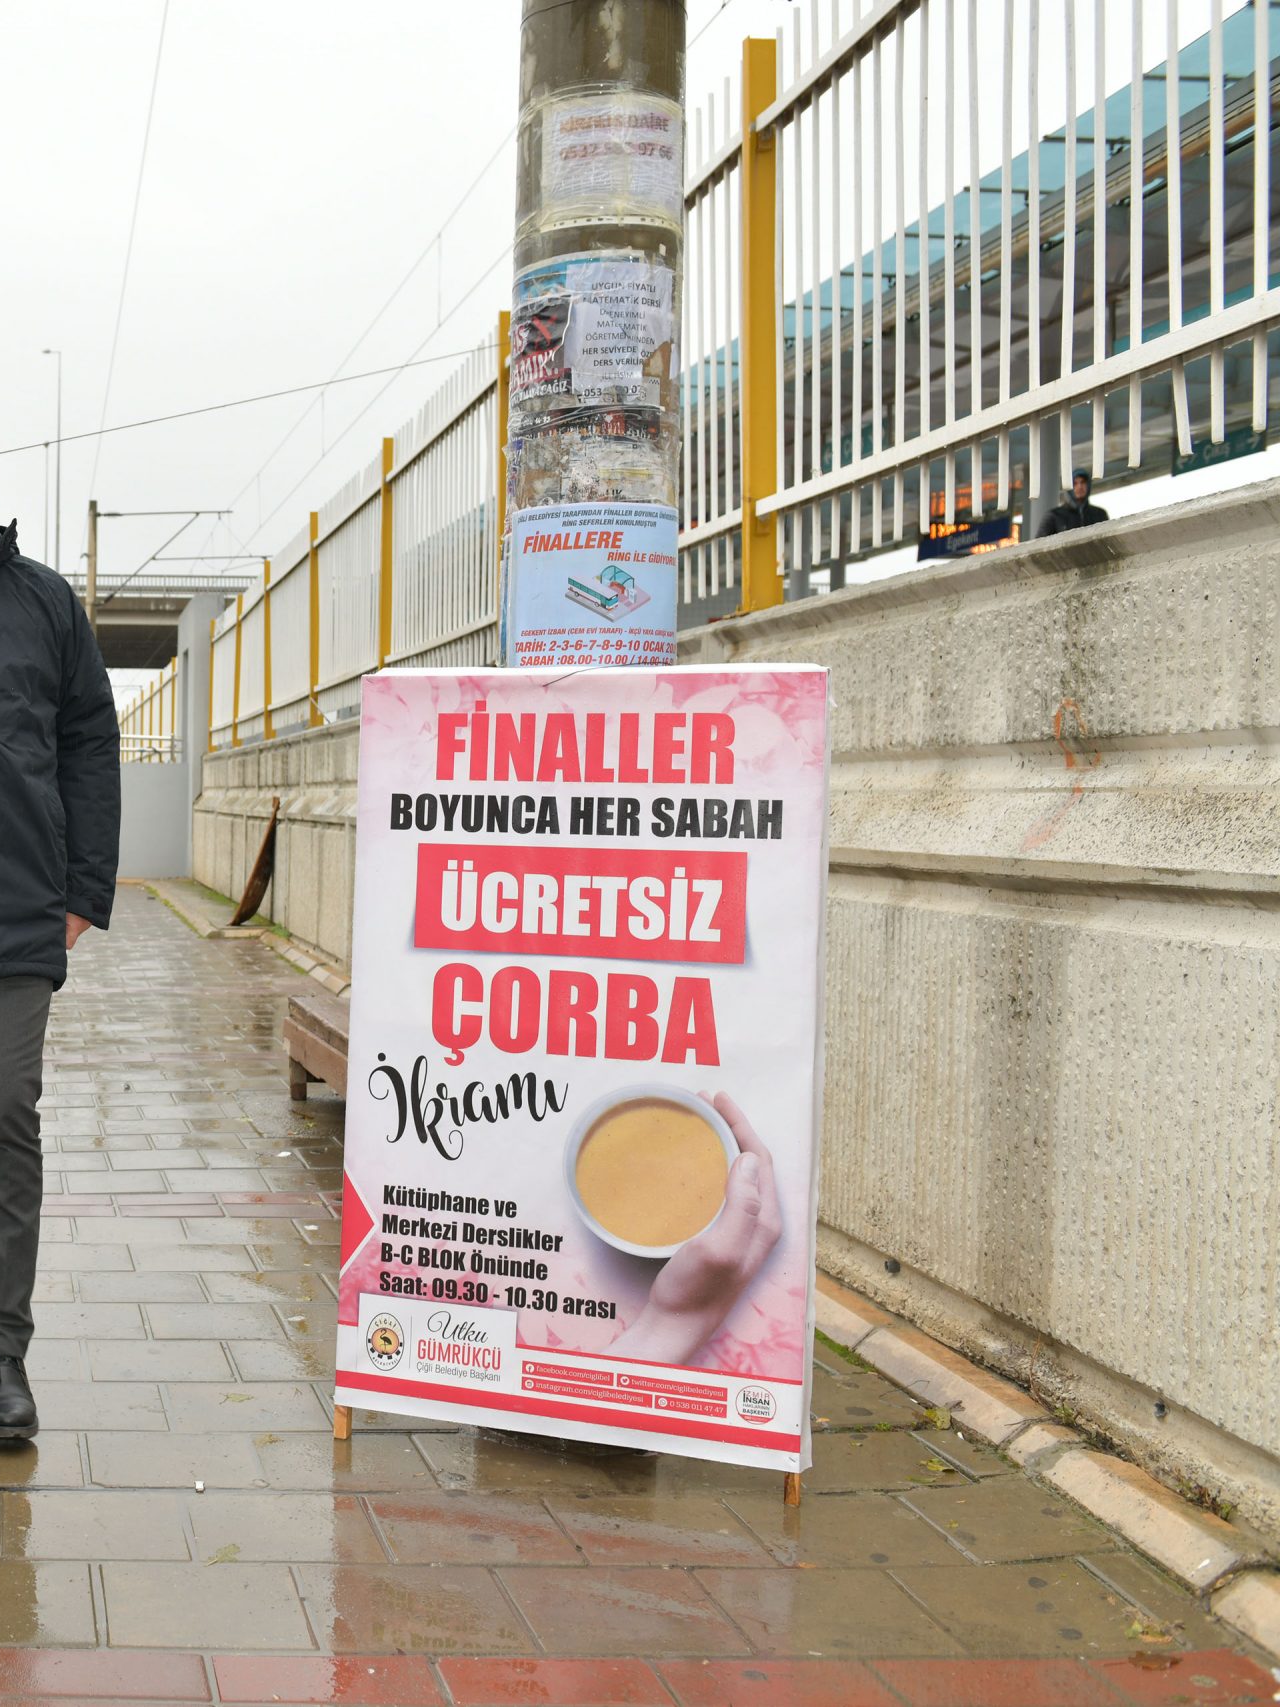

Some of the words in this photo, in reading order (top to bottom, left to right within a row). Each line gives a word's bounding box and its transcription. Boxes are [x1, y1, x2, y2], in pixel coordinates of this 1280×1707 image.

[641, 297, 661, 308] DERSİ
[582, 347, 599, 356] HER
[600, 345, 637, 355] SEVİYEDE
[593, 359, 614, 367] DERS
[615, 357, 644, 366] VERİLİR
[562, 509, 602, 518] TARAFINDAN
[603, 507, 633, 517] FİNALLER
[578, 518, 614, 527] SEFERLERİ
[615, 519, 657, 528] KONULMUŞTUR
[523, 530, 624, 554] FİNALLERE
[607, 550, 631, 562] RİNG
[633, 551, 647, 563] İLE
[547, 628, 567, 636] İZBAN
[586, 627, 598, 635] EVİ
[515, 638, 546, 653] TARİH:
[549, 639, 641, 651] 2-3-6-7-8-9-10
[642, 641, 665, 653] OCAK
[520, 655, 554, 666] SABAH
[435, 700, 736, 785] FİNALLER
[390, 793, 561, 835] BOYUNCA
[569, 797, 641, 837] HER
[651, 798, 784, 840] SABAH
[440, 860, 723, 943] ÜCRETSİZ
[431, 963, 721, 1067] ÇORBA
[368, 1052, 569, 1161] İkramı
[383, 1184, 490, 1216] Kütüphane
[494, 1199, 517, 1218] ve
[381, 1213, 458, 1241] Merkezi
[462, 1222, 563, 1252] Derslikler
[380, 1242, 413, 1265] B-C
[417, 1247, 466, 1272] BLOK
[470, 1249, 548, 1281] Önünde
[379, 1271, 428, 1296] Saat:
[431, 1277, 489, 1303] 09.30
[504, 1286, 558, 1313] 10.30
[562, 1296, 617, 1320] arası
[427, 1310, 489, 1344] Utku
[417, 1338, 502, 1373] GÜMRÜKÇÜ
[416, 1361, 434, 1374] Çiğli
[435, 1364, 469, 1378] Belediye
[470, 1368, 502, 1382] Başkanı
[536, 1365, 611, 1382] facebook.com/ciglibel
